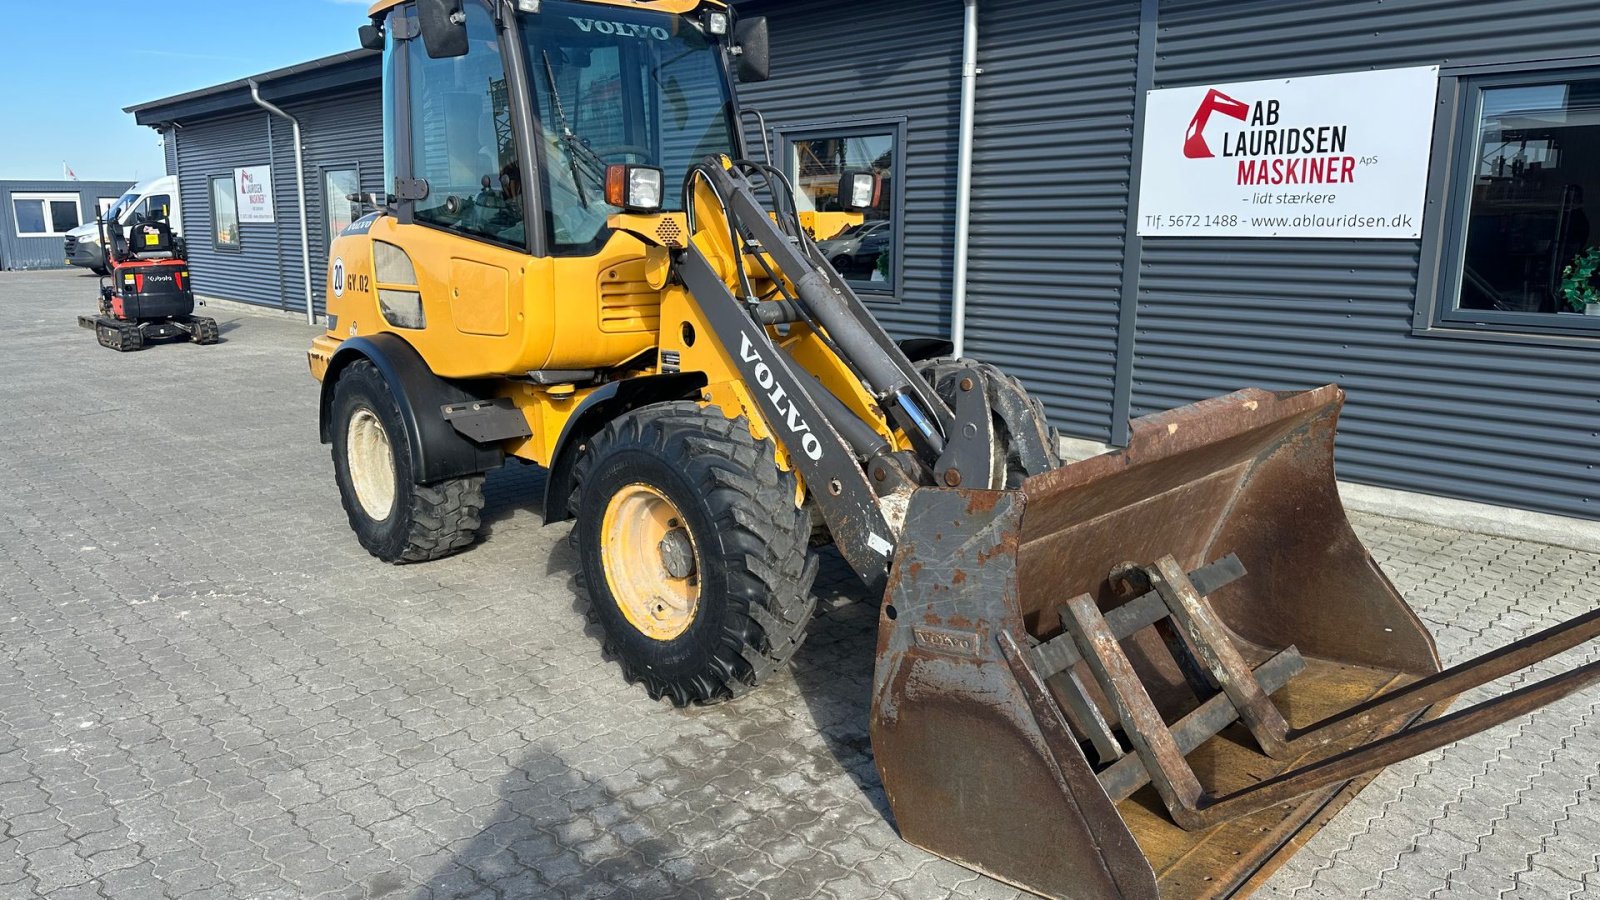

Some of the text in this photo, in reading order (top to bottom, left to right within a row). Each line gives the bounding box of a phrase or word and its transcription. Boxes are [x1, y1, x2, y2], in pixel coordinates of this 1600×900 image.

[567, 16, 669, 41] VOLVO
[1251, 99, 1280, 127] AB
[1222, 125, 1347, 157] LAURIDSEN
[1237, 155, 1378, 185] MASKINER ApS
[1252, 192, 1273, 205] lidt
[1275, 192, 1336, 205] stærkere
[1145, 215, 1164, 230] Tlf.
[1168, 215, 1201, 228] 5672
[1204, 215, 1238, 228] 1488
[1251, 214, 1412, 229] www.ablauridsen.dk
[334, 264, 343, 291] 20
[740, 330, 823, 461] VOLVO
